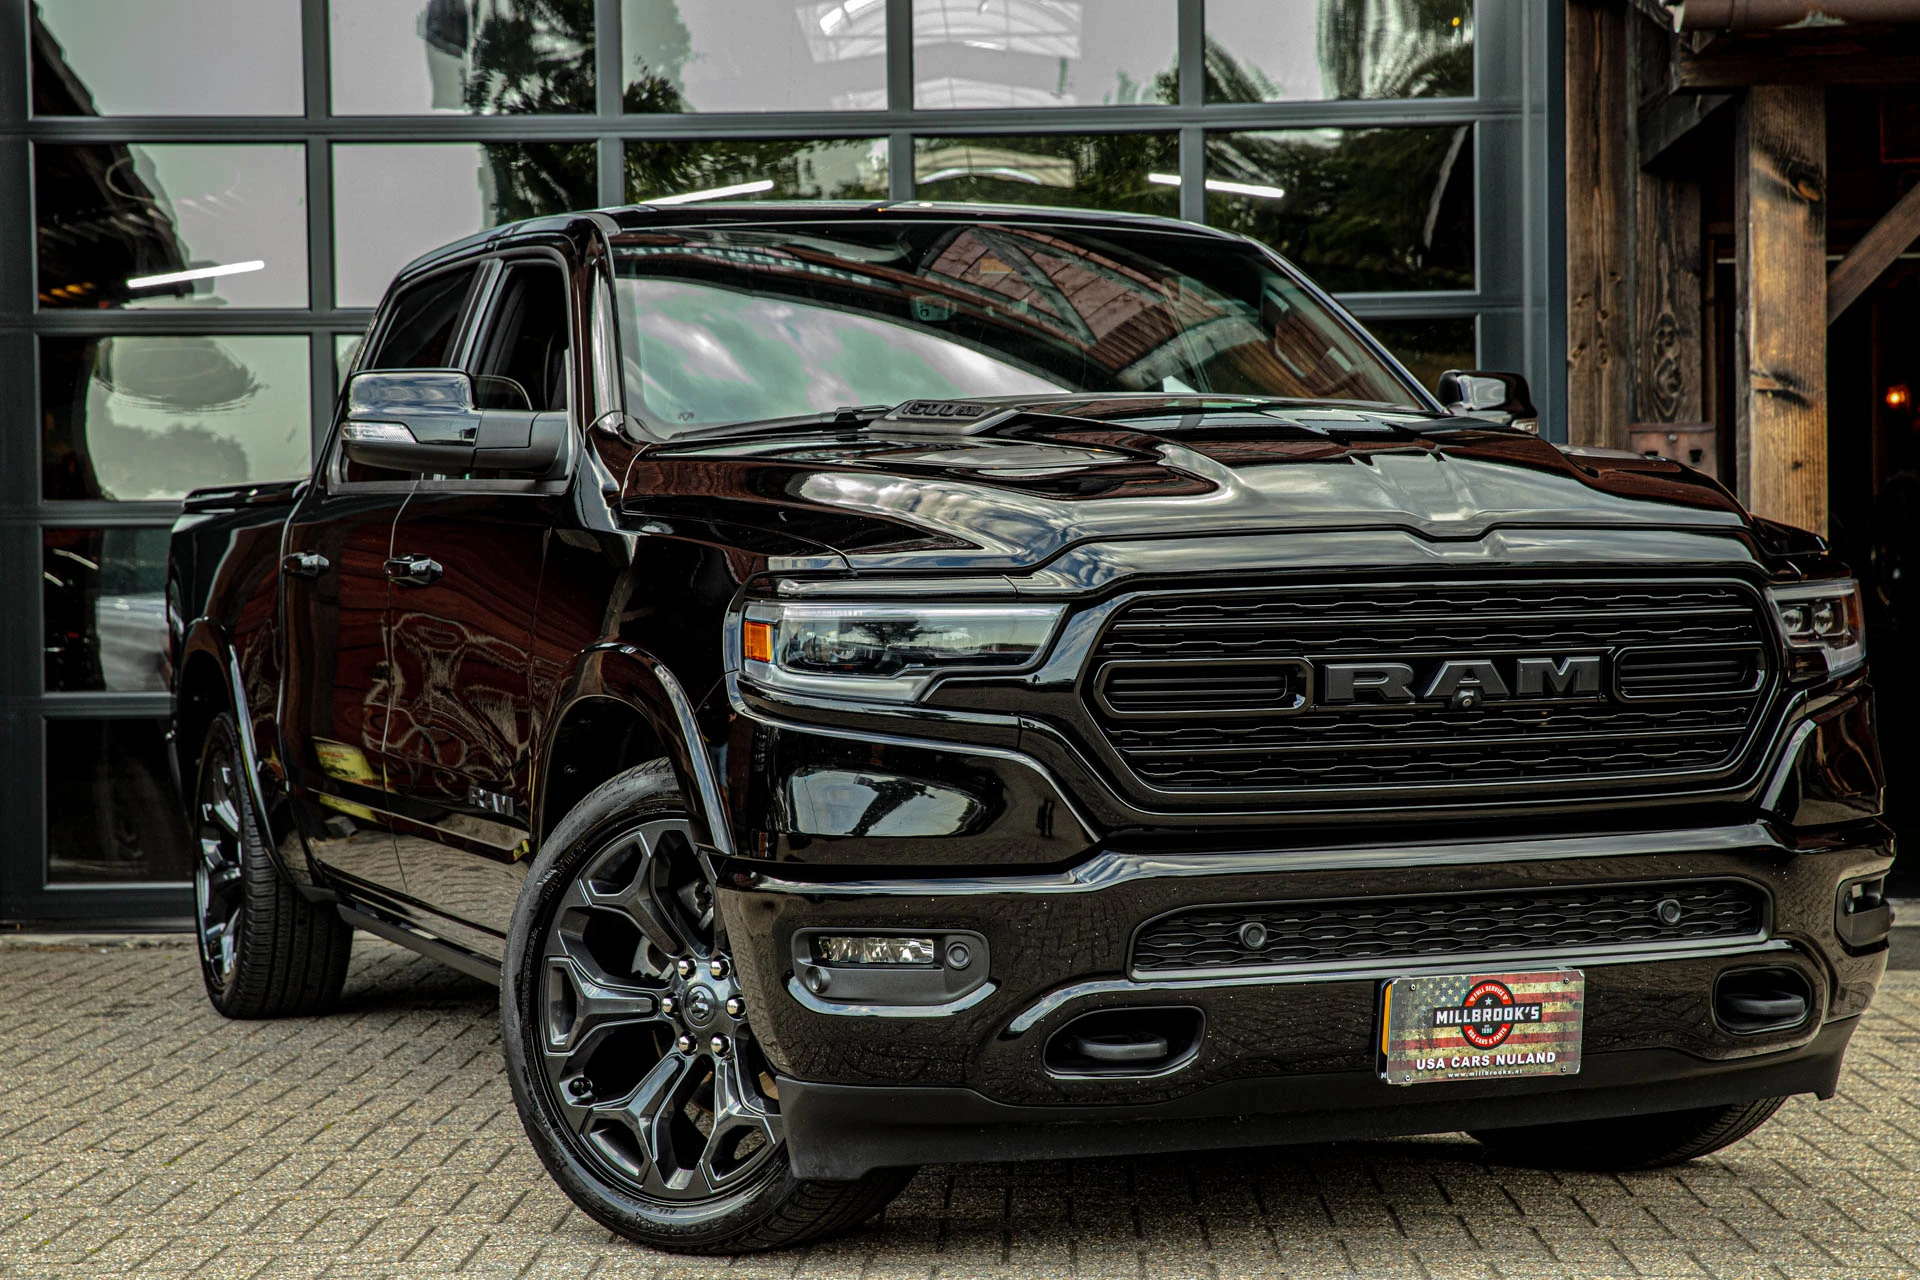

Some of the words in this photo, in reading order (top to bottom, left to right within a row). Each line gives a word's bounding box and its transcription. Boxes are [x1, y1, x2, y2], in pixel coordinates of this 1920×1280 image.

[1325, 656, 1600, 702] RAM
[1485, 985, 1505, 997] SERVICE
[1436, 1006, 1540, 1025] MILLBROOK'S
[1416, 1058, 1446, 1071] USA
[1451, 1055, 1490, 1068] CARS
[1495, 1052, 1556, 1066] NULAND
[1447, 1068, 1523, 1079] www.millbrooks.nl
